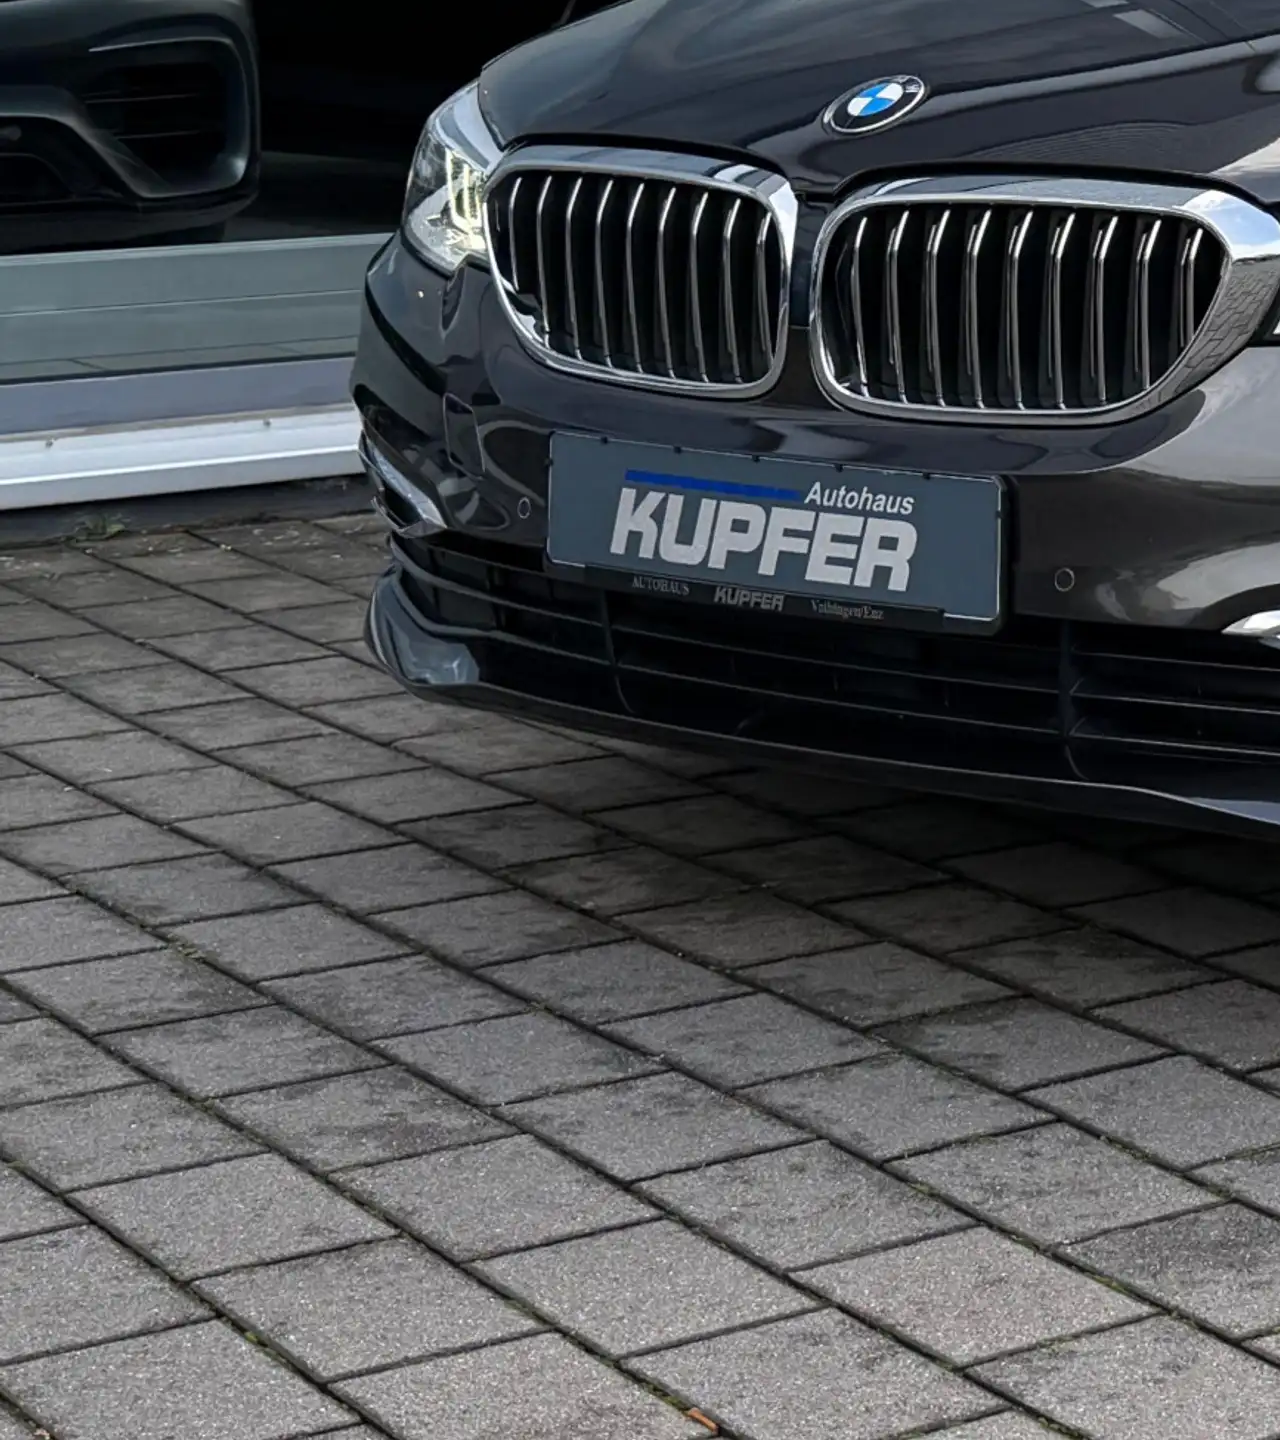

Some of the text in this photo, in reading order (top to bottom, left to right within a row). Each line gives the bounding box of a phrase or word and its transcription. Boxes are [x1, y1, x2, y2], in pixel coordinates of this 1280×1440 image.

[804, 481, 915, 516] Autohaus
[610, 488, 918, 591] KUPFER
[713, 586, 785, 612] KUPFER
